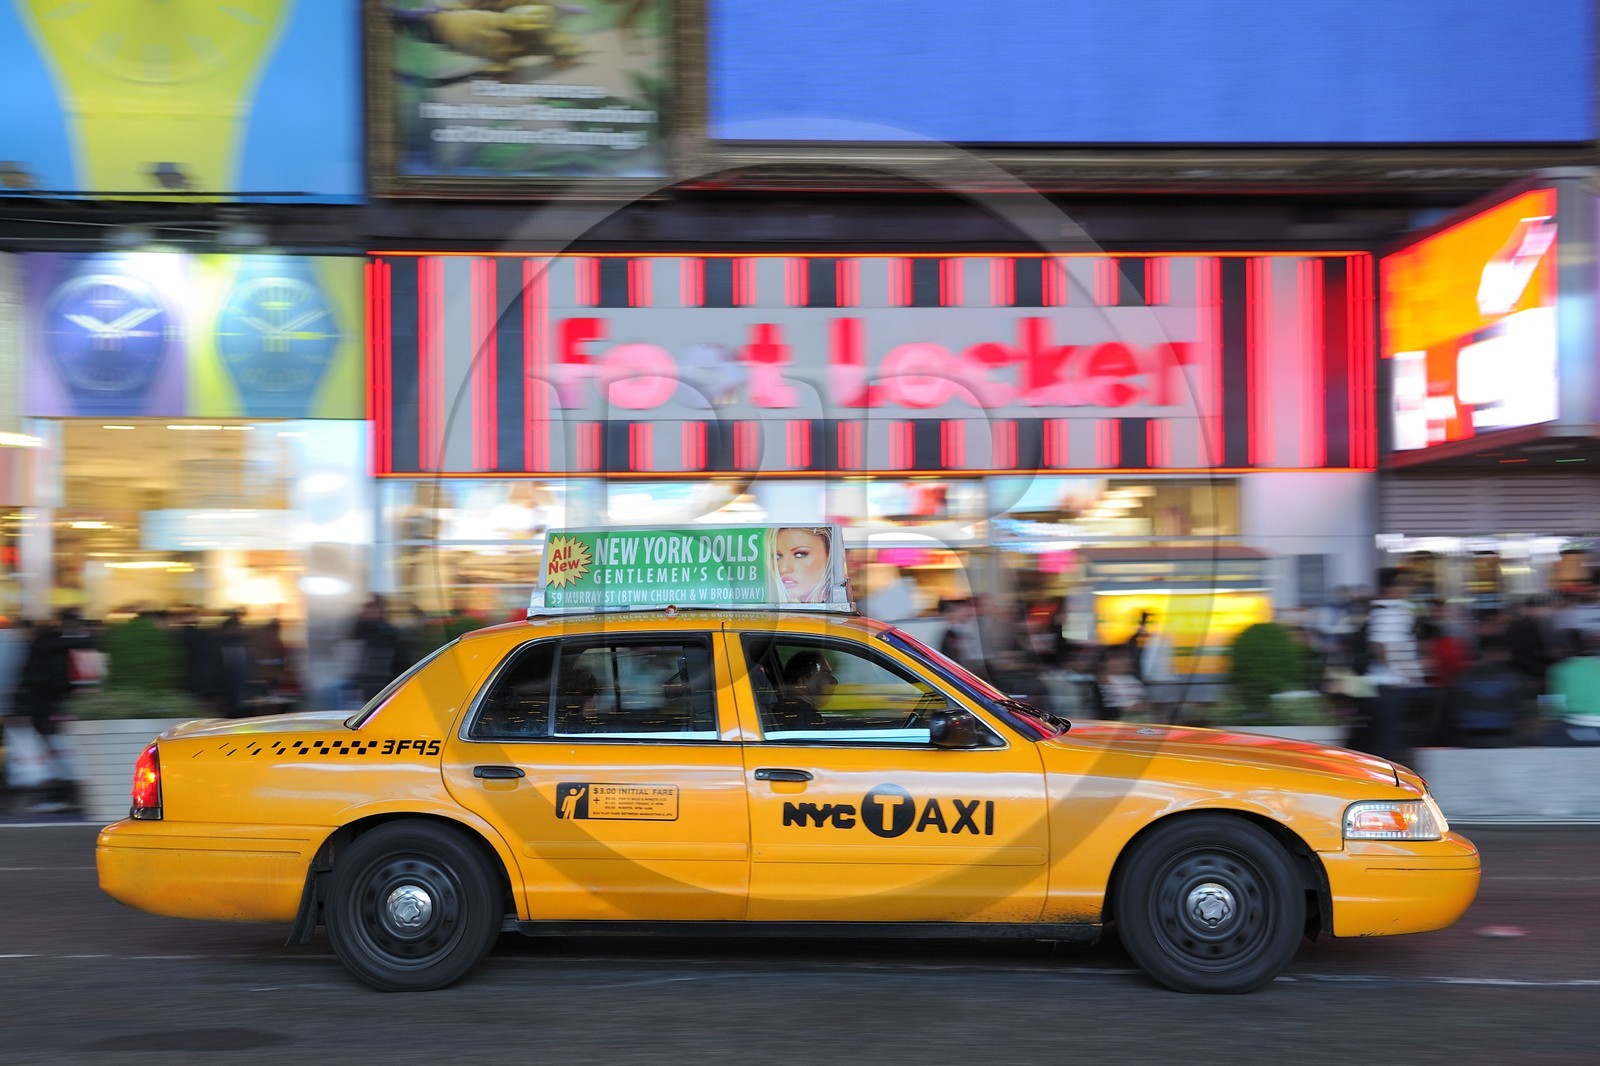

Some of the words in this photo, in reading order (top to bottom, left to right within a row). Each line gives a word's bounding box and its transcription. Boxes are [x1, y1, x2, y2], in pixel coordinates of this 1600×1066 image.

[553, 546, 571, 562] All
[594, 538, 640, 566] NEW
[644, 536, 694, 564] YORK
[699, 534, 758, 563] DOLLS
[548, 559, 580, 575] New
[593, 566, 707, 584] GENTLEMEN'S
[717, 565, 757, 581] CLUB
[551, 592, 562, 604] 59
[565, 591, 602, 604] MURRAY
[605, 590, 615, 603] ST
[617, 589, 648, 604] (BTWN
[650, 589, 687, 602] CHURCH
[689, 588, 697, 601] &
[699, 588, 708, 601] W
[711, 586, 765, 602] BROADWAY)
[381, 740, 441, 756] 3F95
[618, 788, 649, 796] INITIAL
[783, 801, 856, 829] NYC
[870, 794, 994, 836] TAXI
